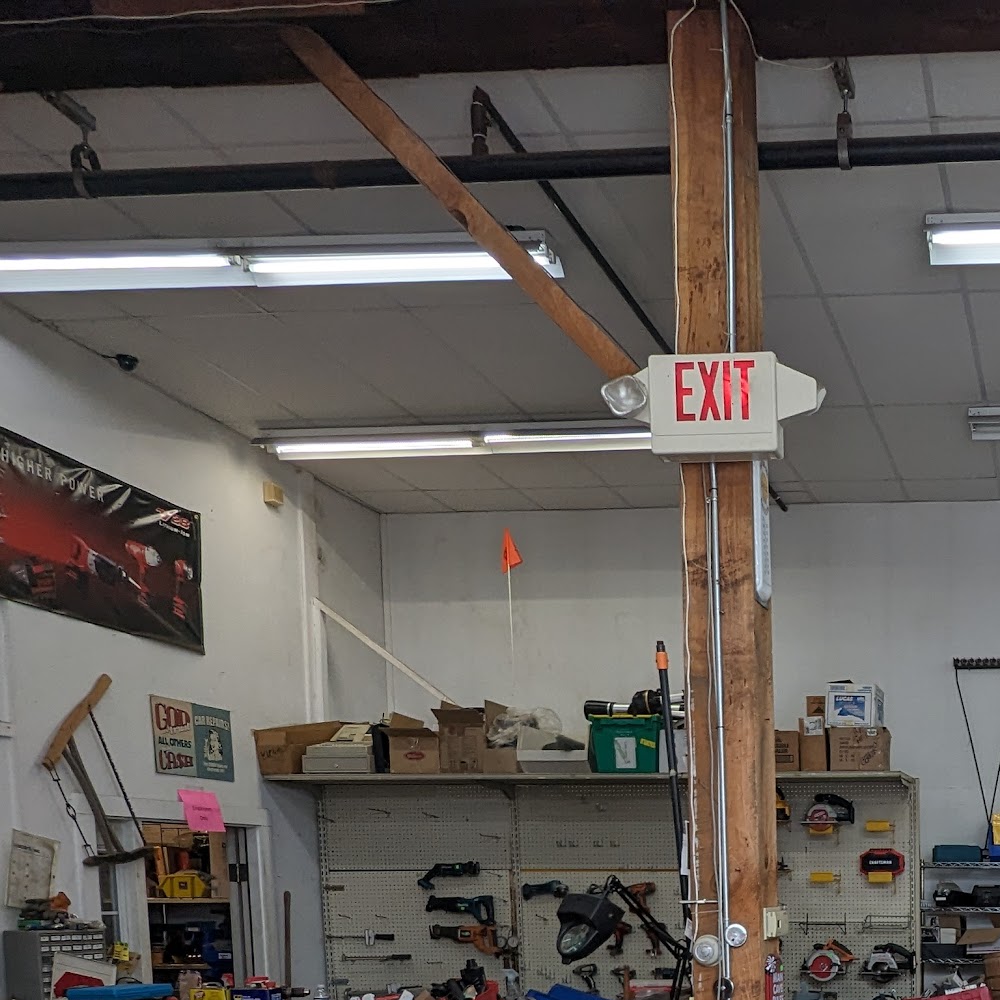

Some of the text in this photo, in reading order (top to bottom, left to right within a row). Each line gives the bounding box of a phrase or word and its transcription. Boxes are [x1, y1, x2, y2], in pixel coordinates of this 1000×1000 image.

[674, 359, 755, 422] EXIT
[1, 448, 104, 503] HIGHER POWER
[158, 736, 168, 746] ALL
